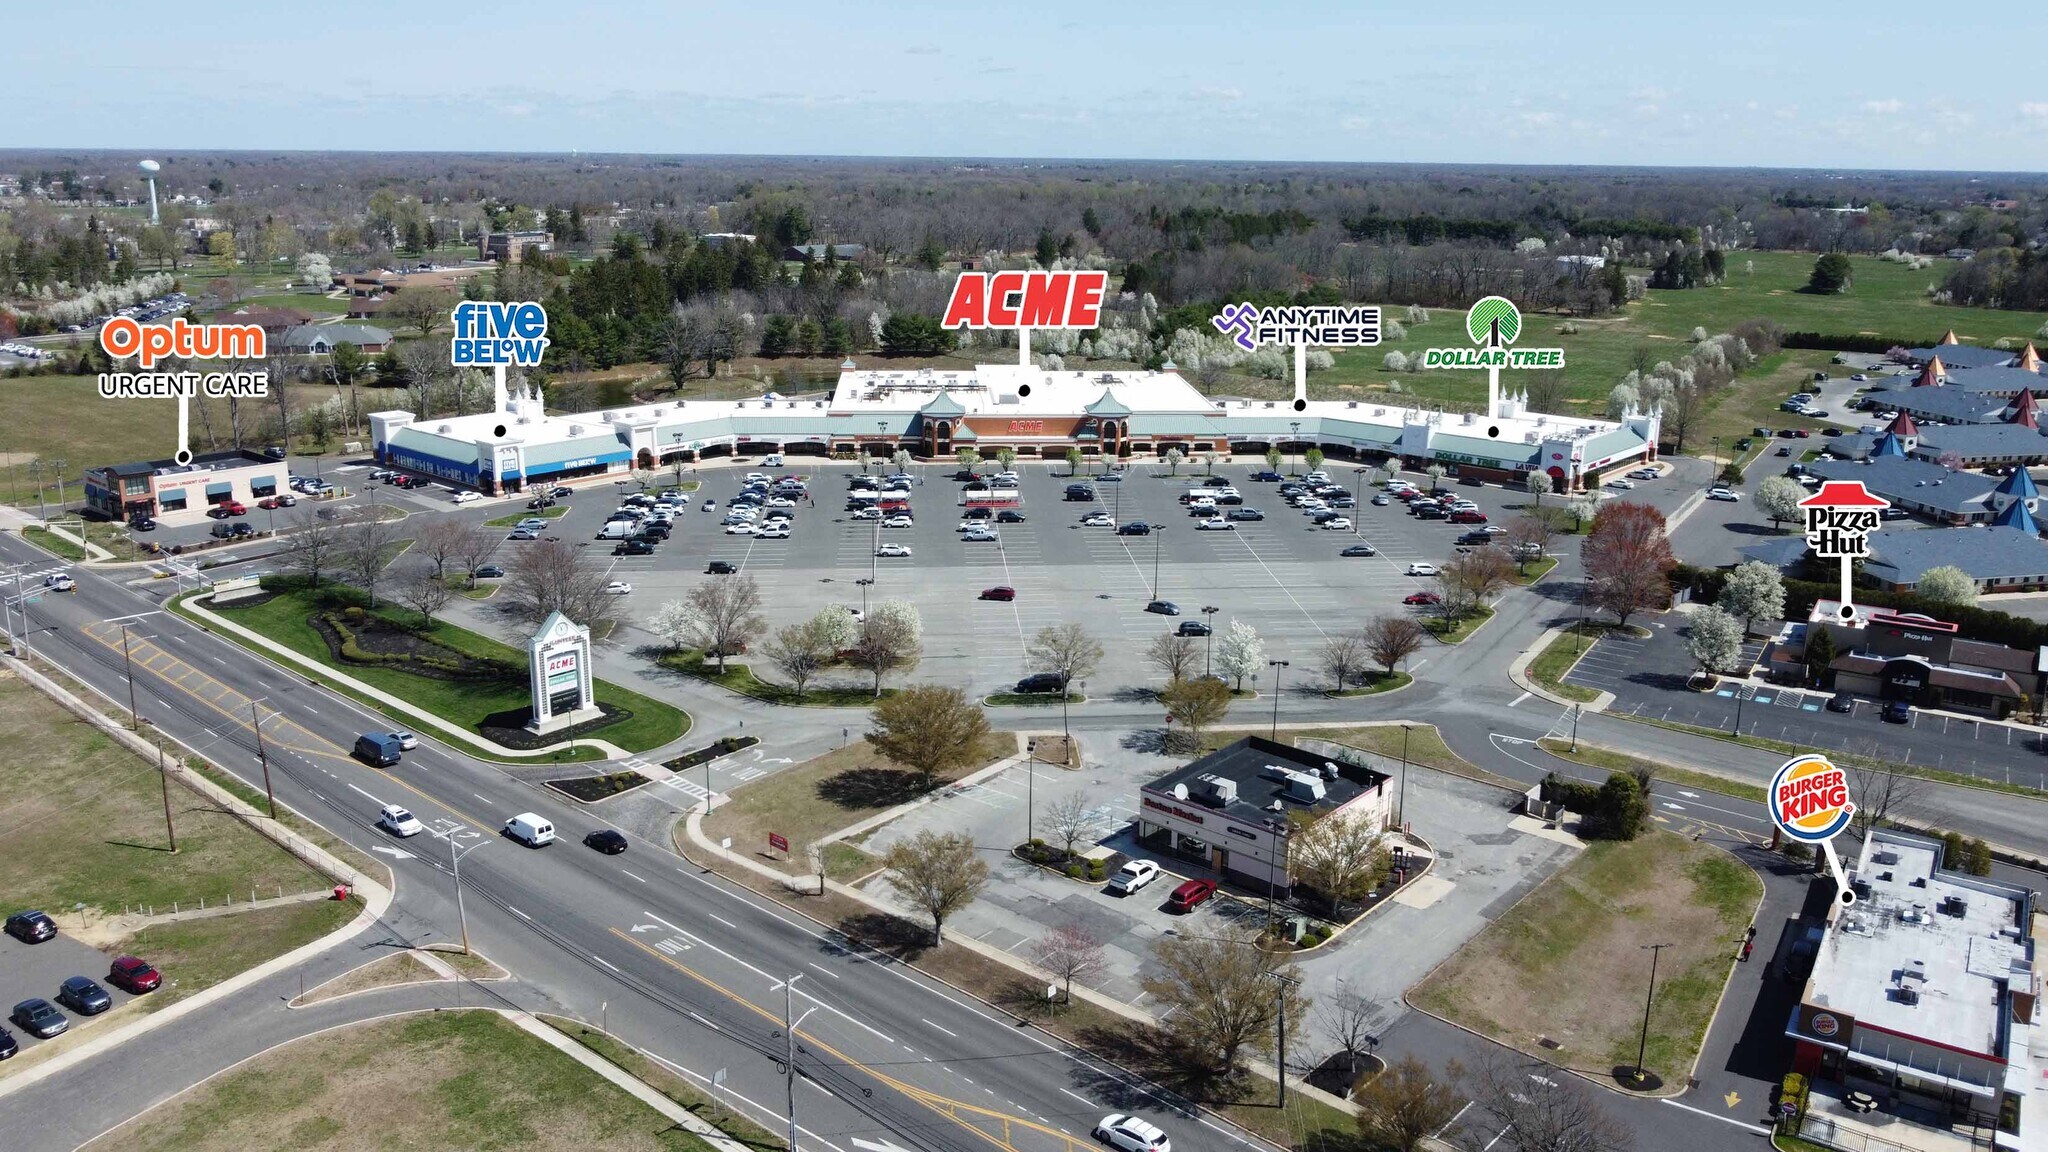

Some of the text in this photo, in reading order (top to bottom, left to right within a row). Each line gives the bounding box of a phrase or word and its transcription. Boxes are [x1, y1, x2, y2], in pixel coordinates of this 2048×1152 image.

[1008, 420, 1043, 432] ACME
[1435, 452, 1502, 468] DOLLAR TREE
[549, 657, 575, 671] ACME
